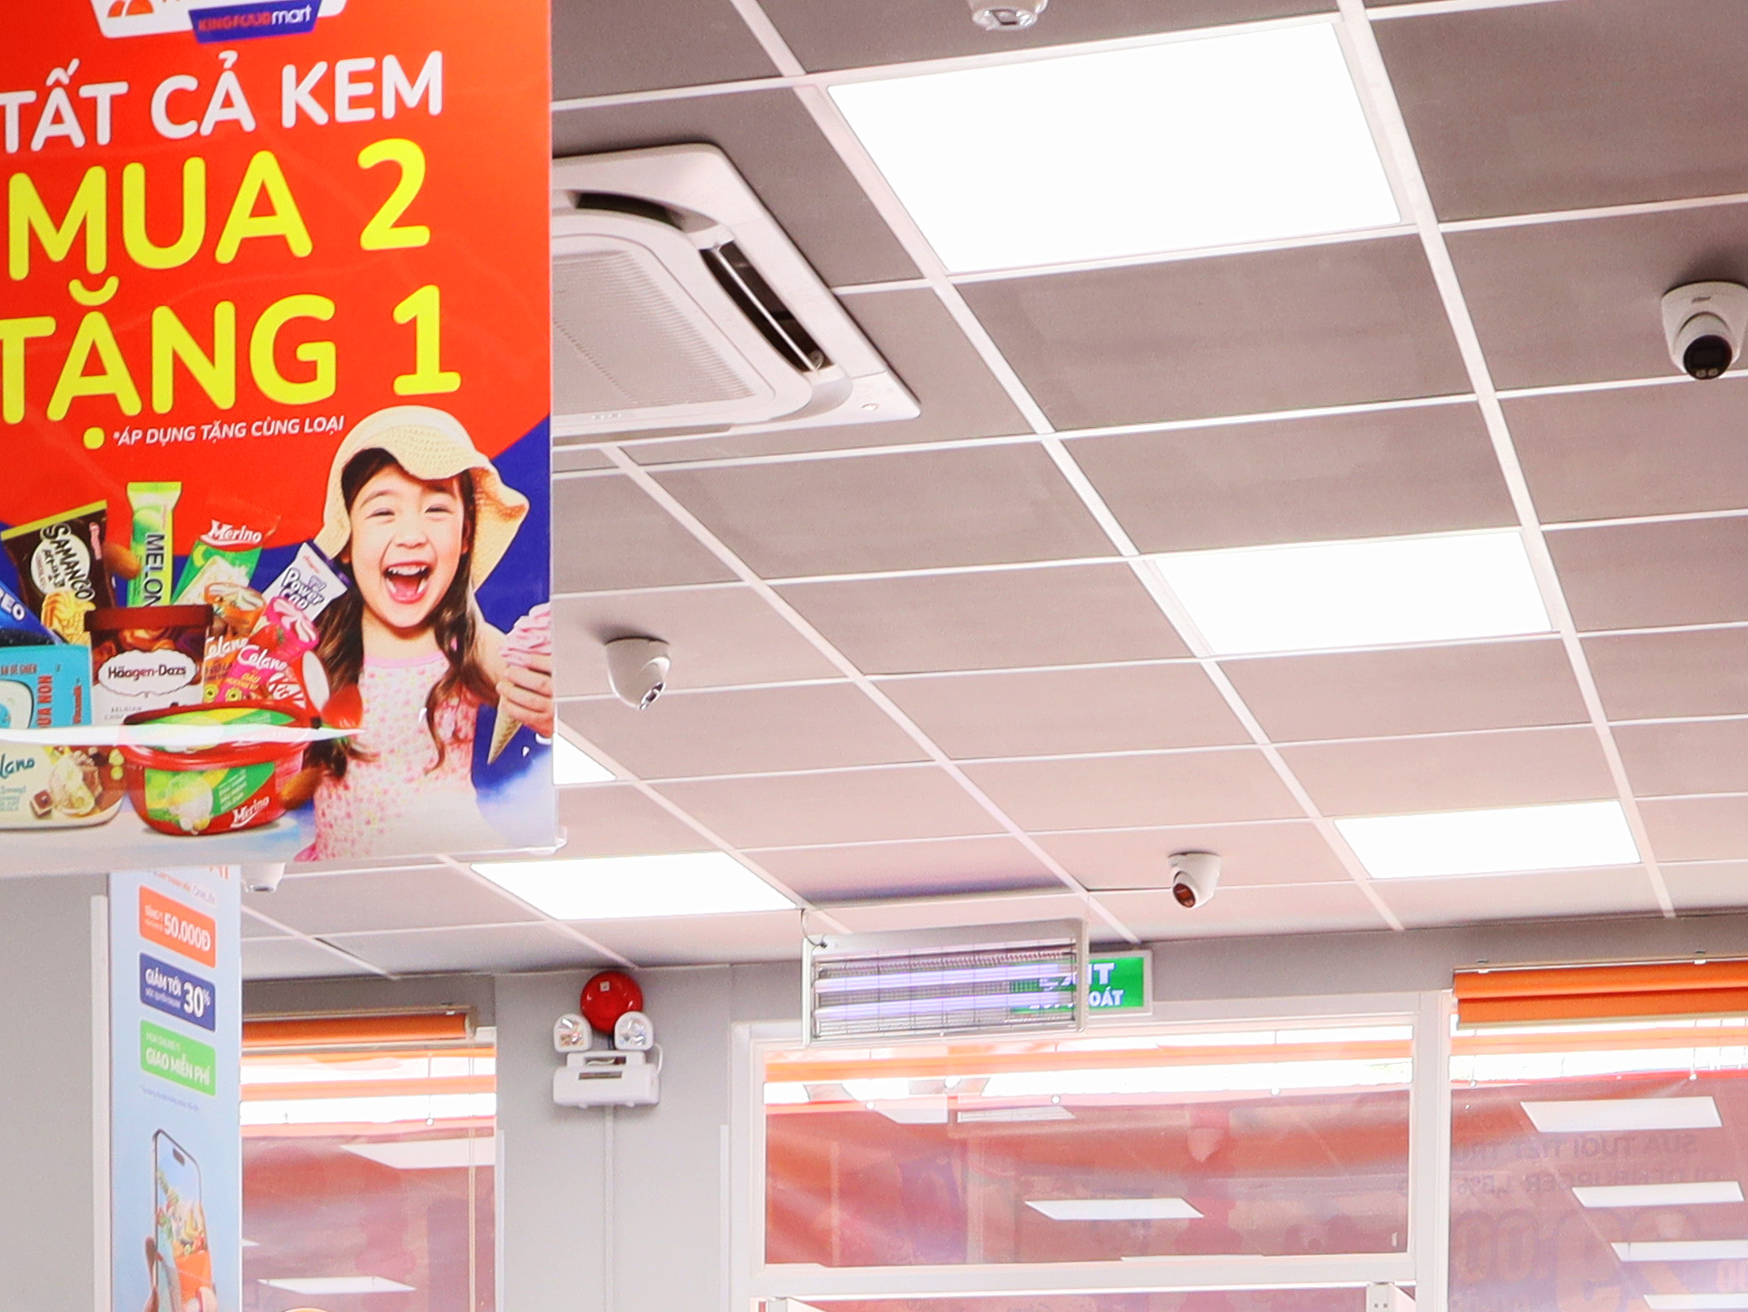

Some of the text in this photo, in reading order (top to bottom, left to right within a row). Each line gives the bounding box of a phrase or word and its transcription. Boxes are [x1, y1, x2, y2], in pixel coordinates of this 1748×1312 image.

[150, 49, 257, 141] CẢ
[281, 50, 445, 129] KEM
[8, 138, 432, 282] MUA 2
[392, 284, 462, 397] 1
[145, 422, 196, 448] DỤNG
[199, 416, 247, 446] TẶNG
[250, 416, 299, 441] CÙNG
[303, 414, 345, 438] LOẠI
